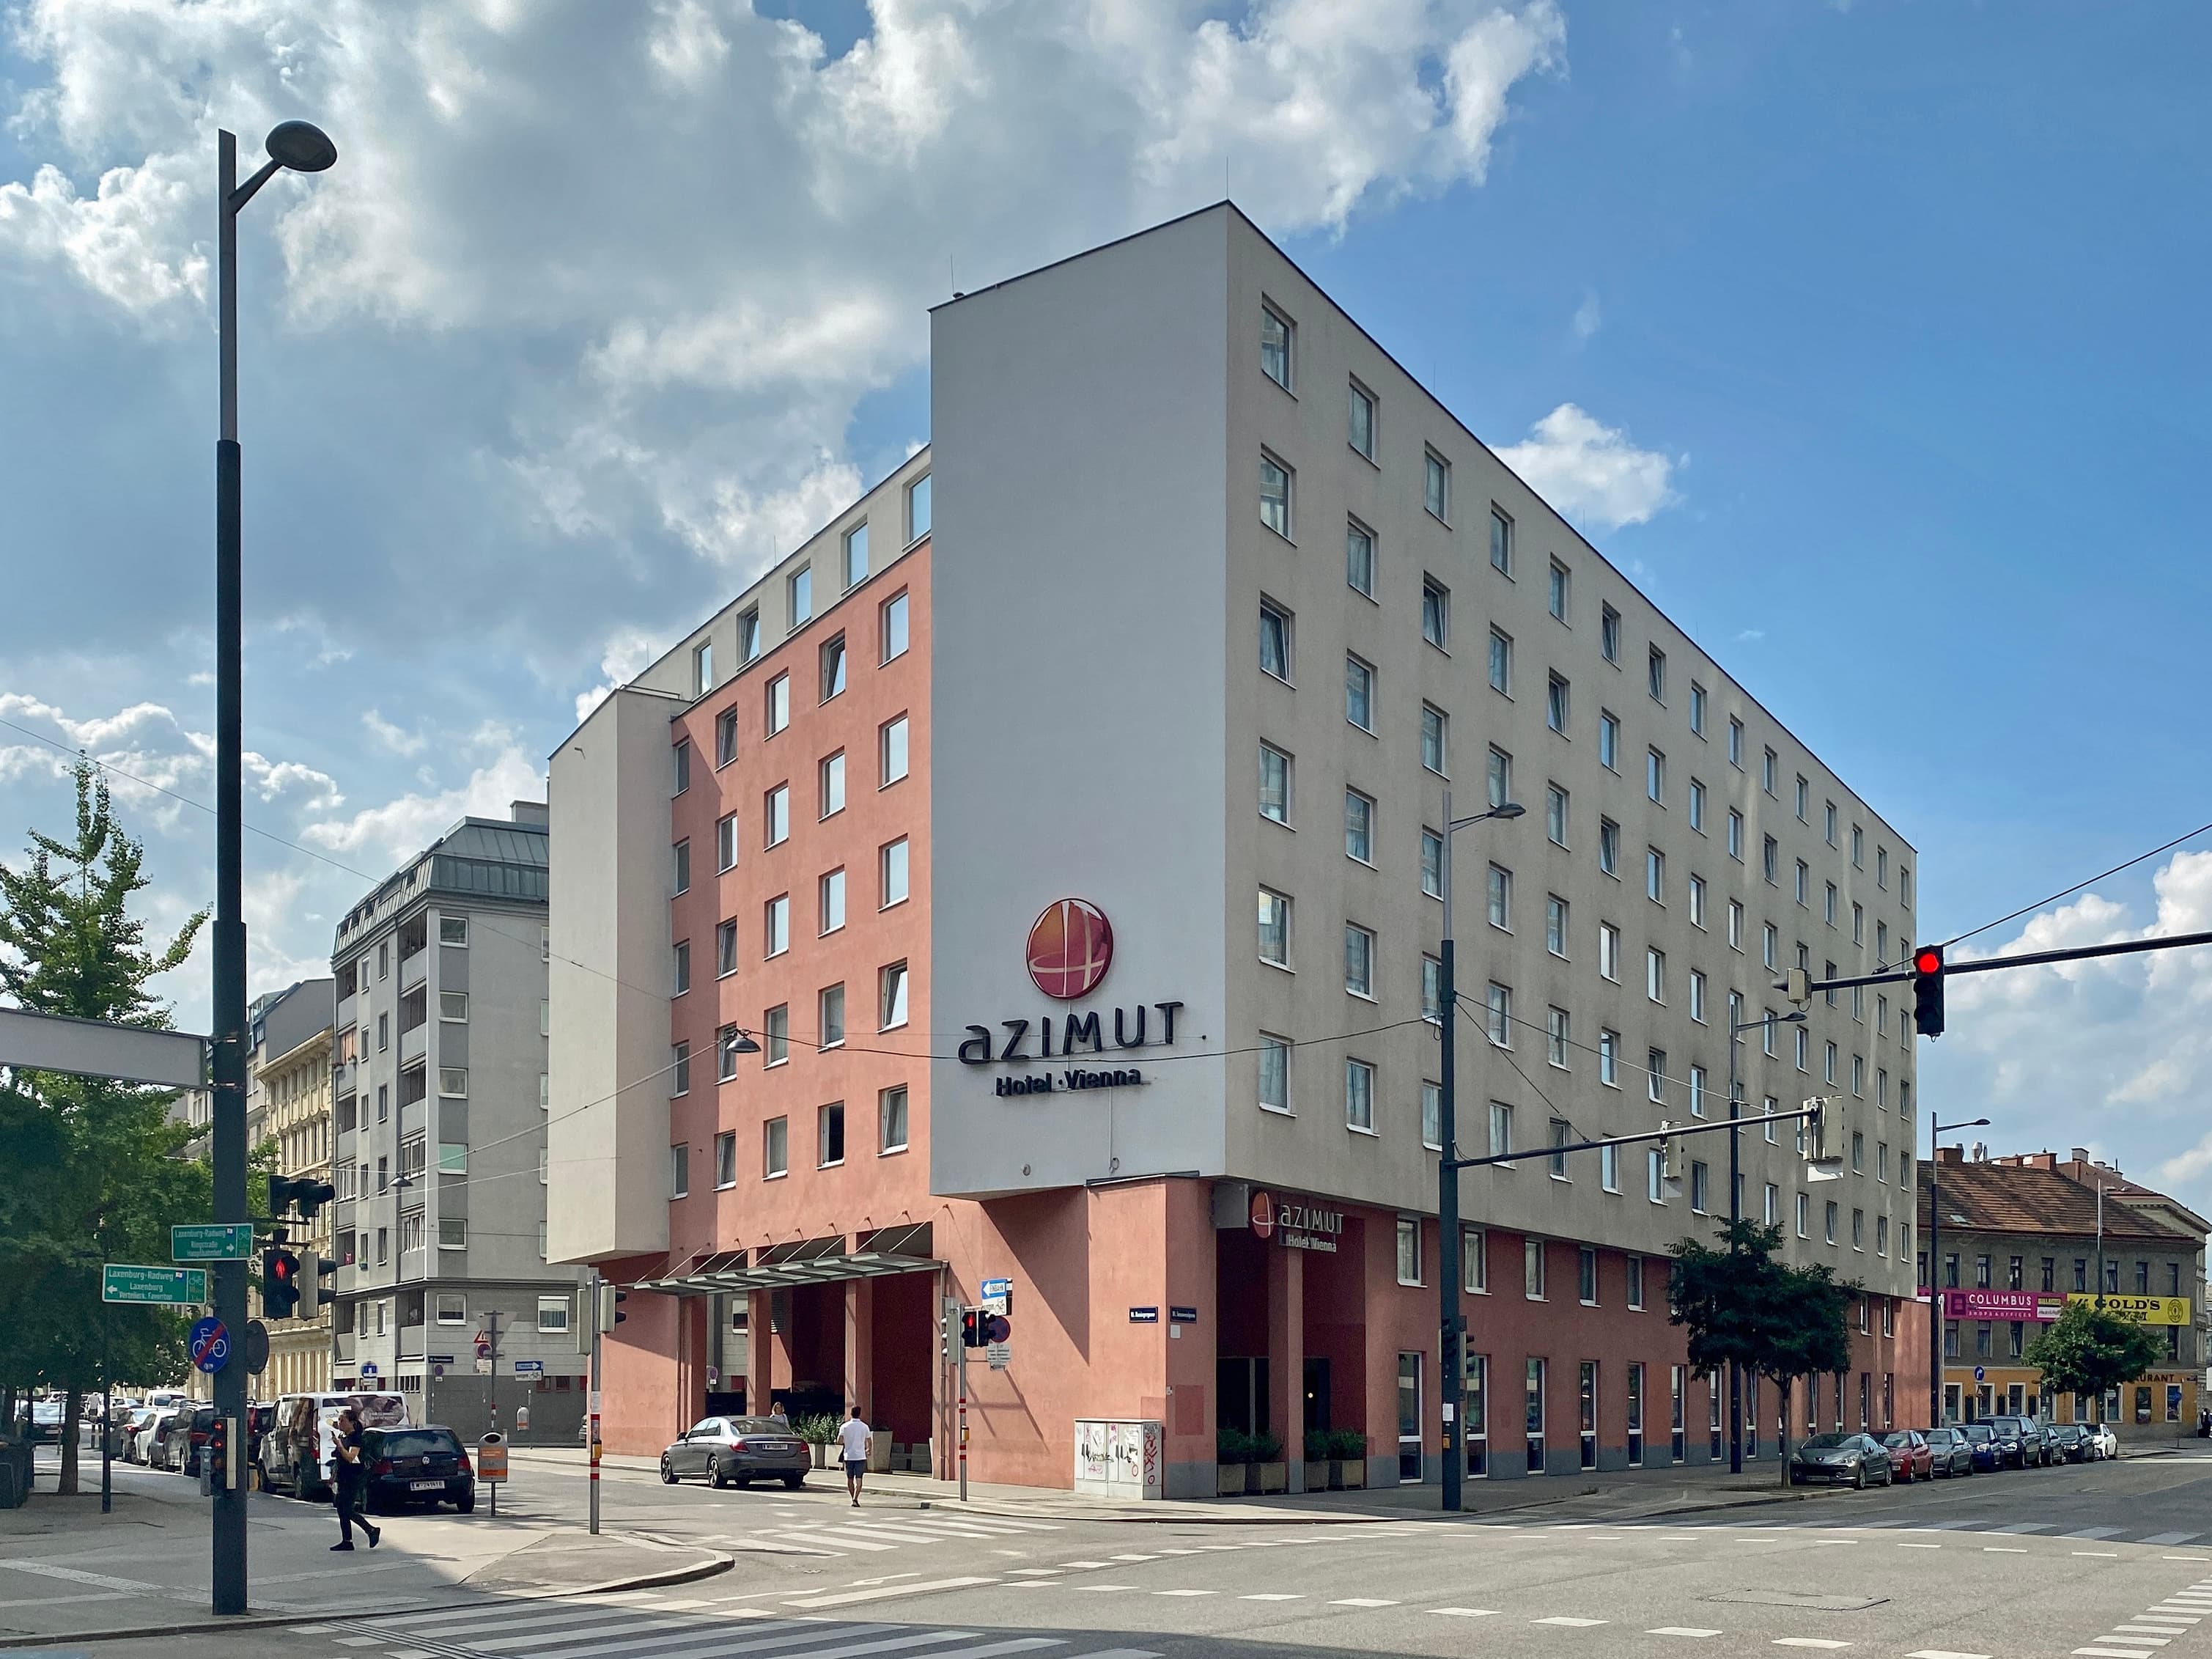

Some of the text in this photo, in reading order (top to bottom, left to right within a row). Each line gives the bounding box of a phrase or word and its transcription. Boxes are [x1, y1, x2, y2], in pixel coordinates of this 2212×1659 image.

[995, 1068, 1142, 1097] Hotel Vienna
[1286, 1235, 1337, 1253] Hotel Vienna
[108, 1268, 174, 1282] Laxenburg-Radweg
[129, 1282, 163, 1292] Laxenburg
[1969, 1294, 2032, 1306] COLUMBUS
